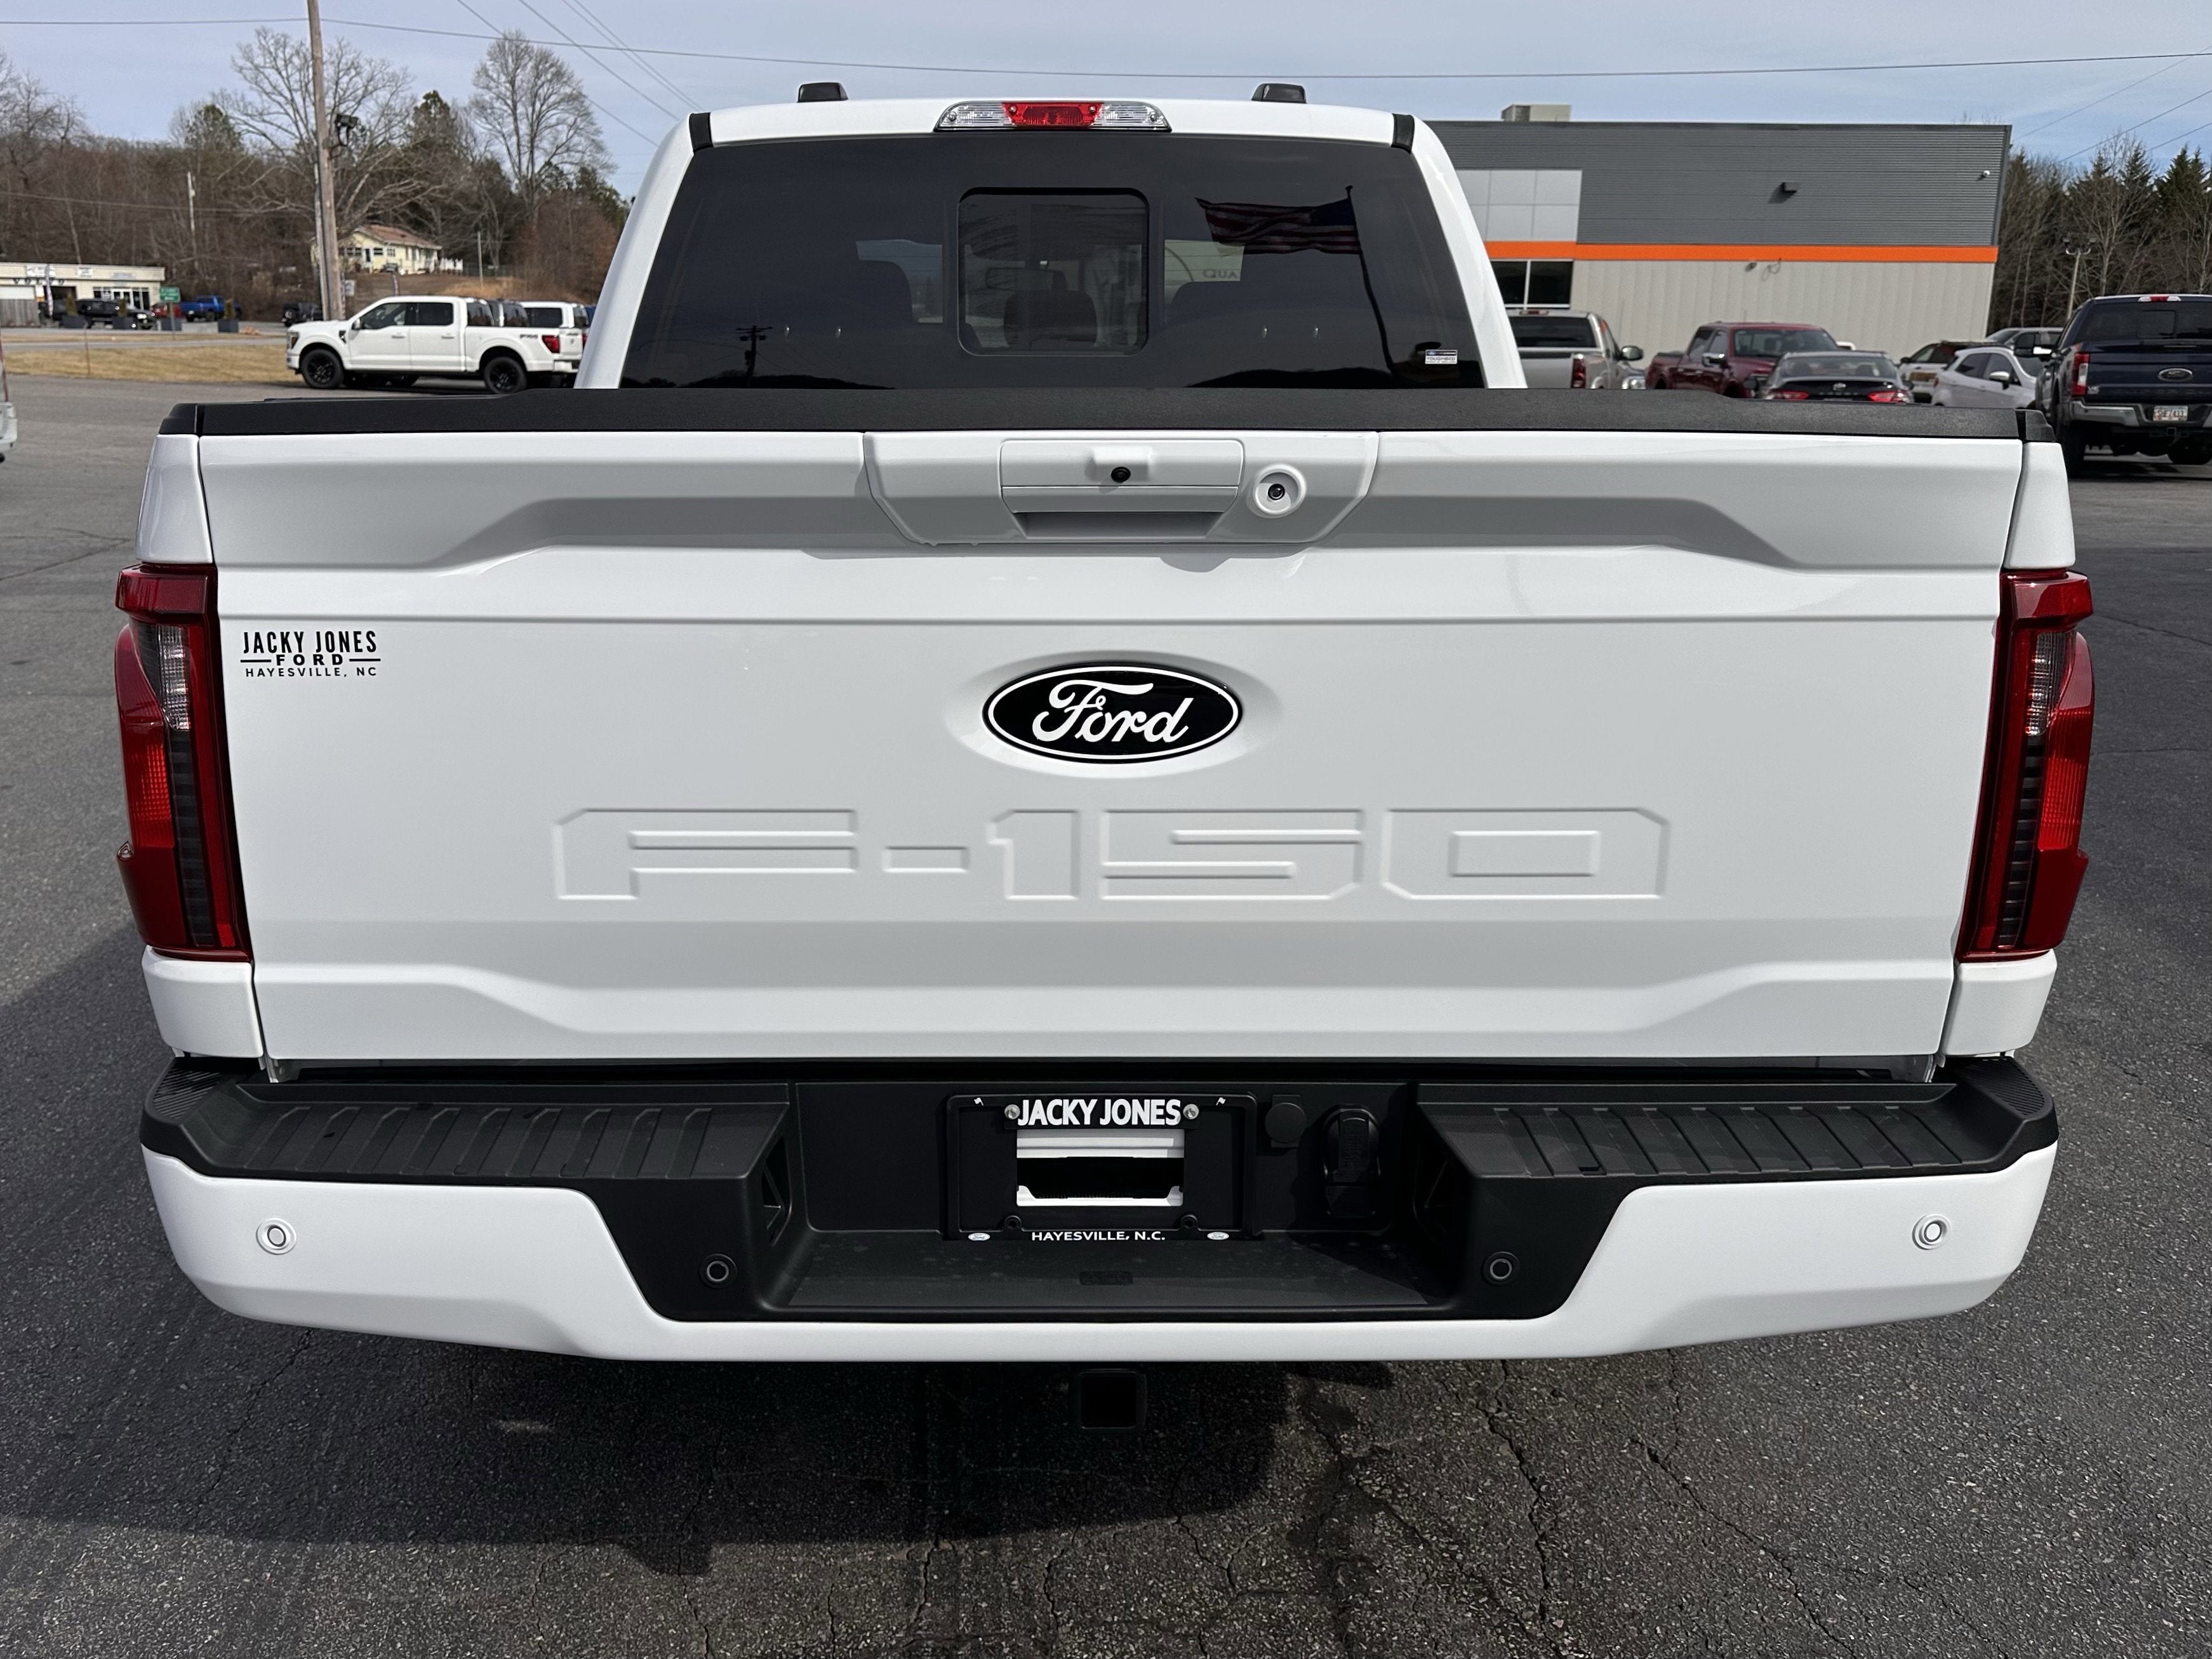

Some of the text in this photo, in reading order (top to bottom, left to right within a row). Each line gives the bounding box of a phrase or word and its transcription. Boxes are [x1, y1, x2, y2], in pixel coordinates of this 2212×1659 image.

[243, 630, 376, 654] JACKY JONES
[245, 667, 376, 677] HAYESVILLE, NC
[276, 654, 343, 666] FORD
[1032, 679, 1194, 743] Ford
[552, 808, 1670, 902] F-150
[1018, 1098, 1181, 1126] JACKY JONES
[1032, 1230, 1166, 1241] HAYESVILLE, N.C.
